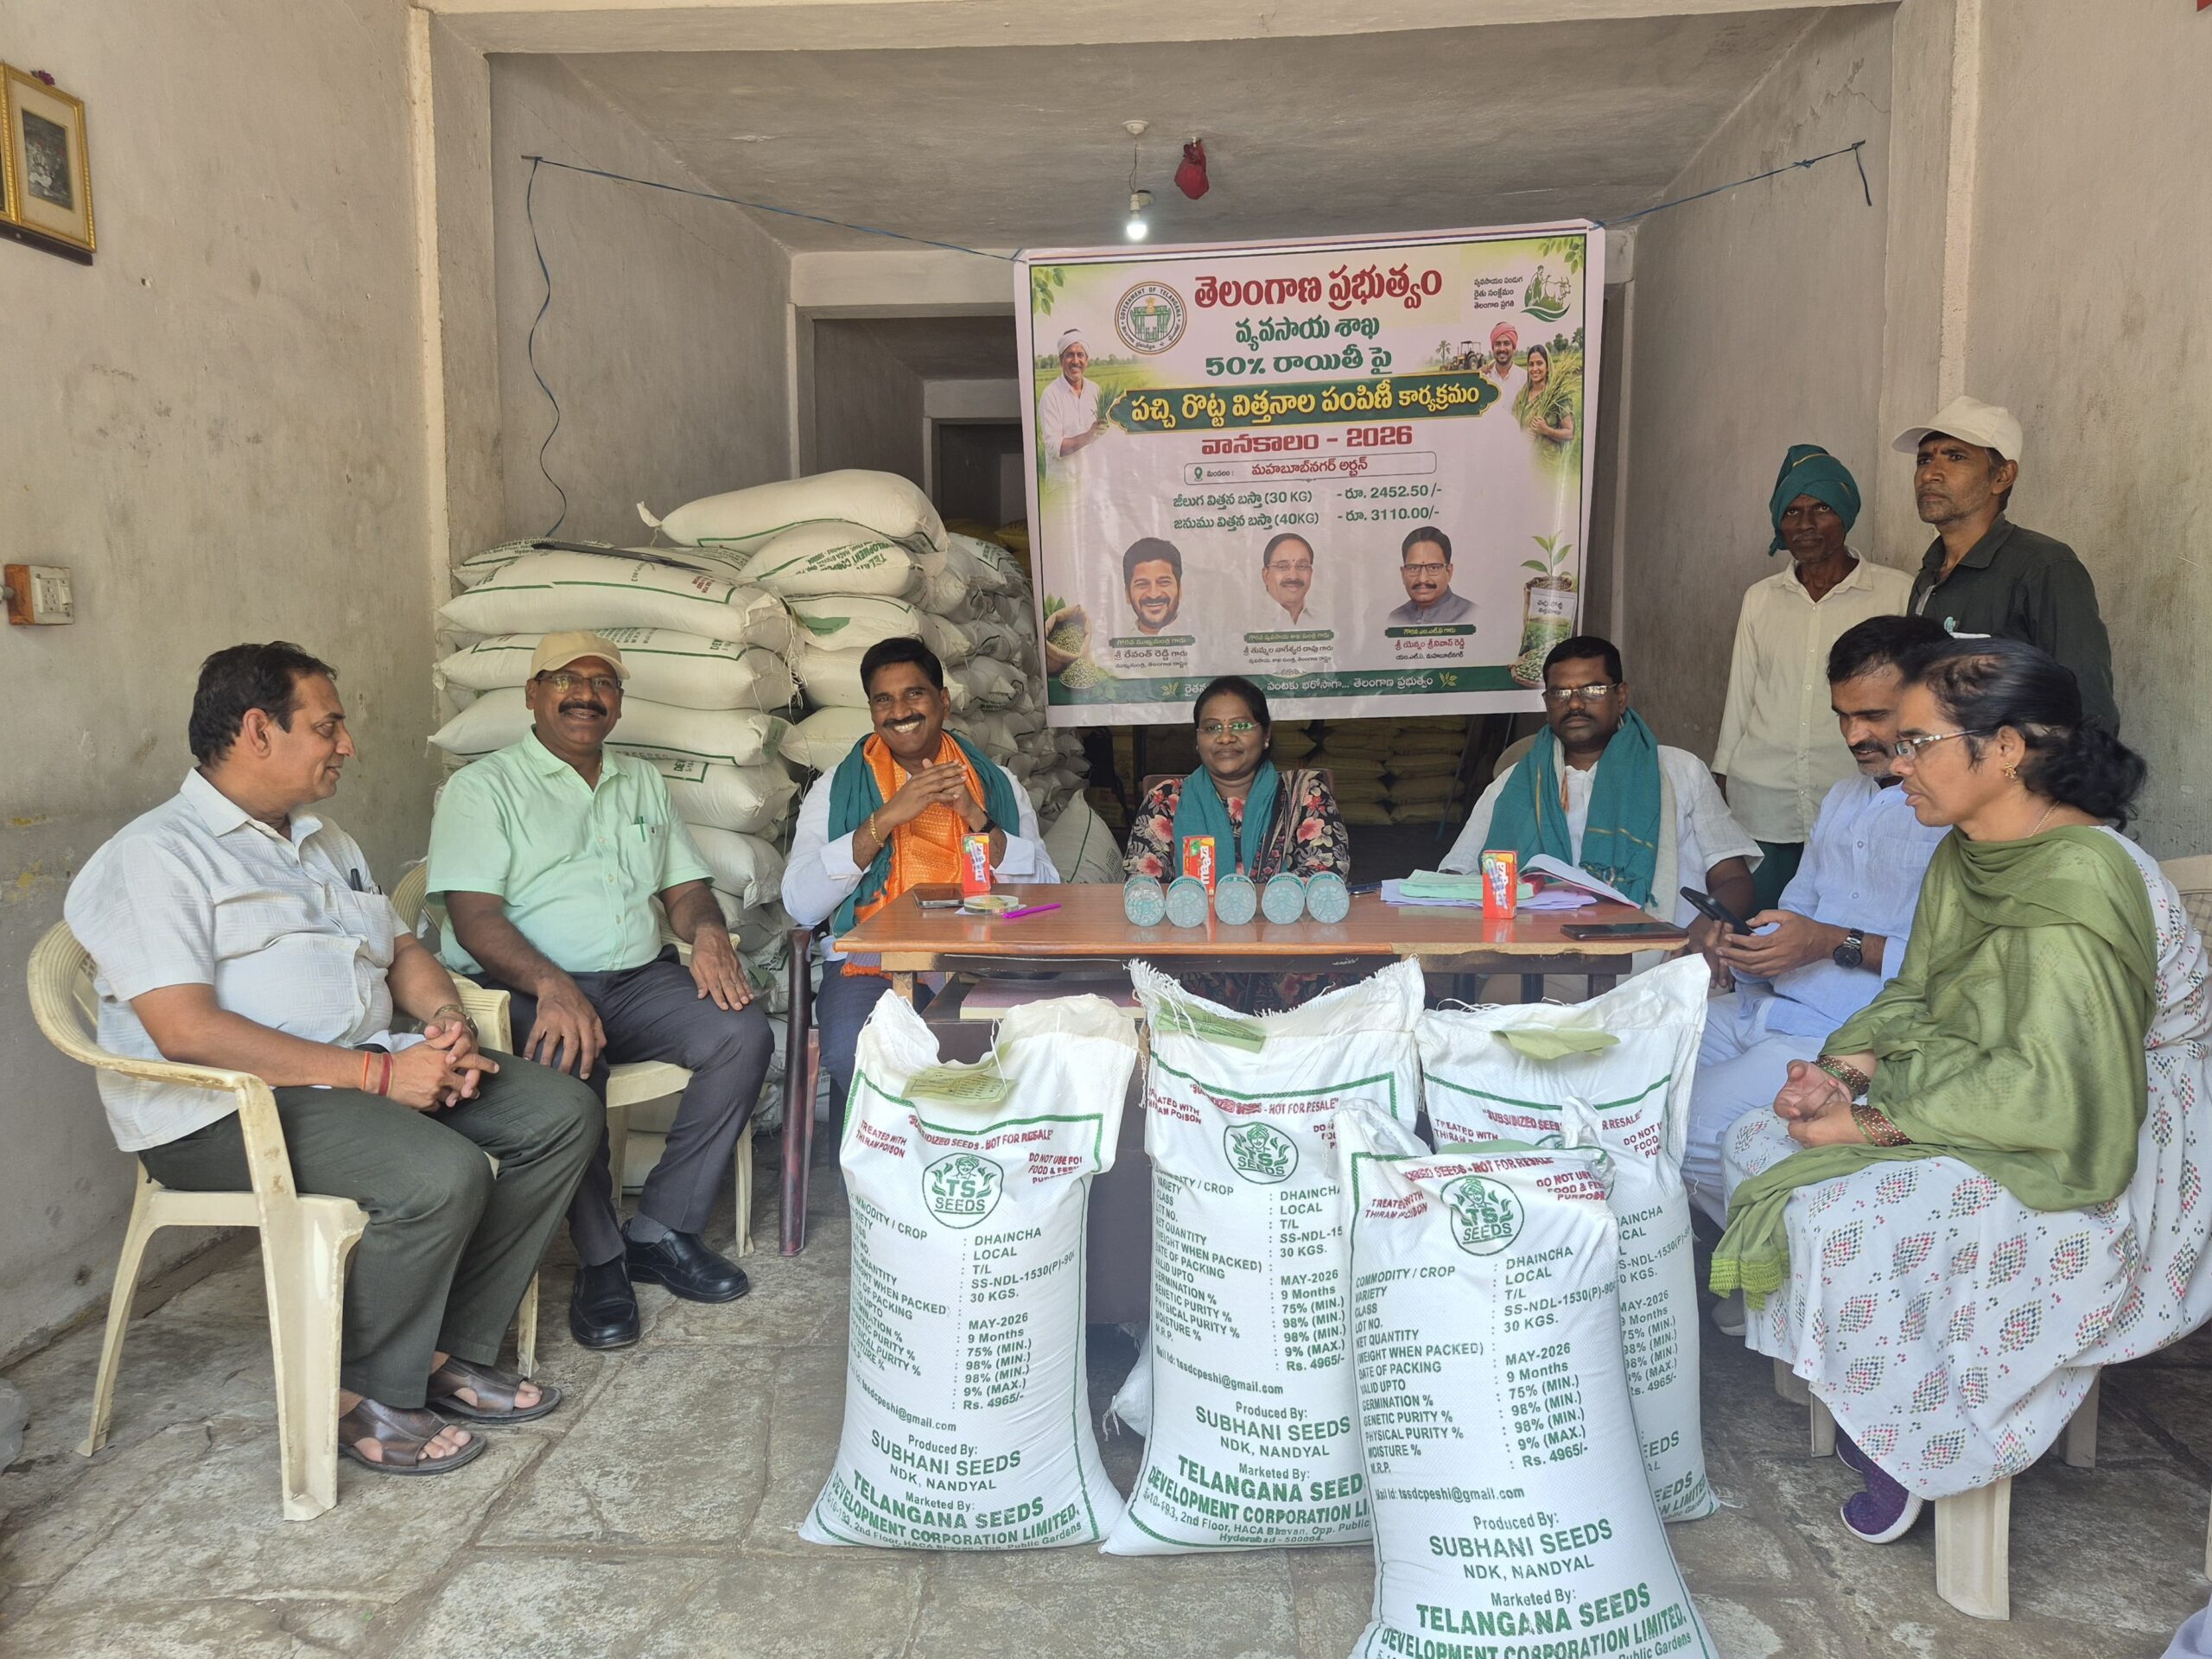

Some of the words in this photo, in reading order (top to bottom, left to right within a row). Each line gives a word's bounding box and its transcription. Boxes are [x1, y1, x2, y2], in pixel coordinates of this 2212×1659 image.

[1194, 276, 1322, 308] తెలంగాణ
[1328, 263, 1442, 311] ప్రభుత్వం
[1119, 288, 1146, 321] GOVERNMENT
[1160, 288, 1182, 318] TELANGANA
[1236, 315, 1331, 353] వ్యవసాయ
[1334, 316, 1380, 340] శాఖ
[1205, 356, 1266, 377] 50%
[1273, 344, 1363, 373] రాయితీ
[1369, 346, 1393, 376] పై
[1131, 395, 1177, 429] పచ్చి
[1181, 392, 1227, 429] రొట్ట
[1231, 389, 1316, 424] విత్తనాల
[1321, 378, 1394, 412] పంపిణీ
[1398, 382, 1480, 413] కార్యక్రమం
[1201, 434, 1319, 455] వానకాలం
[1346, 425, 1413, 448] 2026
[1339, 456, 1369, 477] అర్బన్
[1173, 493, 1205, 508] జీలుగ
[1206, 493, 1236, 511] విత్తన
[1237, 491, 1263, 509] బస్తా
[1264, 491, 1287, 505] (30
[1290, 490, 1313, 503] KG)
[1370, 485, 1428, 499] 2452.50
[1173, 516, 1215, 531] జనుము
[1217, 514, 1246, 532] విత్తన
[1248, 512, 1274, 531] బస్తా
[1274, 512, 1319, 526] (40KG)
[1370, 505, 1440, 522] 3110.00/-
[1114, 650, 1122, 661] శ్రీ
[1123, 649, 1154, 659] రేవంత్
[1154, 649, 1170, 662] రెడ్డి
[1267, 681, 1299, 691] పంటకు
[1353, 677, 1394, 689] తెలంగాణ
[1397, 676, 1434, 690] ప్రభుత్వం
[946, 1179, 977, 1198] TS
[935, 1198, 986, 1212] SEEDS
[1465, 1207, 1499, 1226] TS
[974, 1227, 1042, 1246] DHAINCHA
[1463, 1222, 1513, 1242] SEEDS
[1506, 1246, 1573, 1270] DHAINCHA
[1356, 1268, 1411, 1288] COMMODITY
[1420, 1266, 1456, 1278] CROP
[1505, 1267, 1552, 1286] LOCAL
[1355, 1286, 1388, 1303] VARIETY
[1504, 1287, 1527, 1300] T/L
[1619, 1289, 1669, 1313] MAY-2026
[1355, 1303, 1377, 1318] CLASS
[969, 1313, 1029, 1331] MAY-2026
[1355, 1320, 1367, 1333] LOT
[1368, 1318, 1382, 1330] NO.
[1504, 1320, 1520, 1333] 30
[1524, 1313, 1559, 1330] KGS.
[1356, 1336, 1367, 1349] NET
[1369, 1329, 1420, 1345] QUANTITY
[1357, 1348, 1387, 1367] (WEIGHT
[1389, 1345, 1422, 1359] WHEN
[1426, 1342, 1484, 1357] PACKED)
[1505, 1342, 1571, 1366] MAY-2026
[1358, 1366, 1374, 1380] DATE
[1376, 1364, 1388, 1376] OF
[1389, 1361, 1442, 1375] PACKING
[1506, 1370, 1515, 1383] 9
[1519, 1362, 1568, 1382] Months
[1645, 1357, 1677, 1382] (MAX.)
[1360, 1382, 1378, 1395] VALID
[1380, 1378, 1406, 1392] UPTO
[1509, 1383, 1538, 1400] 75%
[1541, 1374, 1580, 1396] (MIN.)
[1362, 1395, 1420, 1412] GERMINATION
[1421, 1395, 1434, 1407] %
[1511, 1402, 1541, 1417] 98%
[1544, 1390, 1582, 1413] (MIN.)
[1195, 1405, 1281, 1441] SUBHANI
[1288, 1416, 1351, 1441] SEEDS
[1363, 1412, 1395, 1427] GENETIC
[1397, 1411, 1438, 1423] PURITY
[1440, 1410, 1453, 1422] %
[871, 1429, 949, 1475] SUBHANI
[956, 1450, 1021, 1477] SEEDS
[1522, 1454, 1547, 1467] Rs.
[1549, 1441, 1588, 1462] 4965/-
[853, 1469, 968, 1529] TELANGANA
[975, 1496, 1045, 1529] SEEDS
[1398, 1486, 1525, 1503] tssdcpeshi@gmail.com
[1180, 1510, 1200, 1527] 2nd
[1202, 1517, 1231, 1534] Floor,
[1234, 1524, 1264, 1535] HACA
[1338, 1518, 1370, 1532] Public
[1472, 1512, 1535, 1530] Produced
[1537, 1511, 1560, 1529] By:
[1219, 1532, 1276, 1543] Hyderabad
[1428, 1535, 1535, 1558] SUBHANI
[1540, 1518, 1613, 1554] SEEDS
[1463, 1564, 1507, 1581] NDK,
[1511, 1554, 1595, 1580] NANDYAL
[1491, 1590, 1552, 1607] Marketed
[1554, 1588, 1577, 1604] By:
[1415, 1603, 1573, 1637] TELANGANA
[1578, 1581, 1652, 1629] SEEDS
[1381, 1627, 1498, 1659] DEVELOPMENT
[1504, 1626, 1630, 1659] CORPORATION
